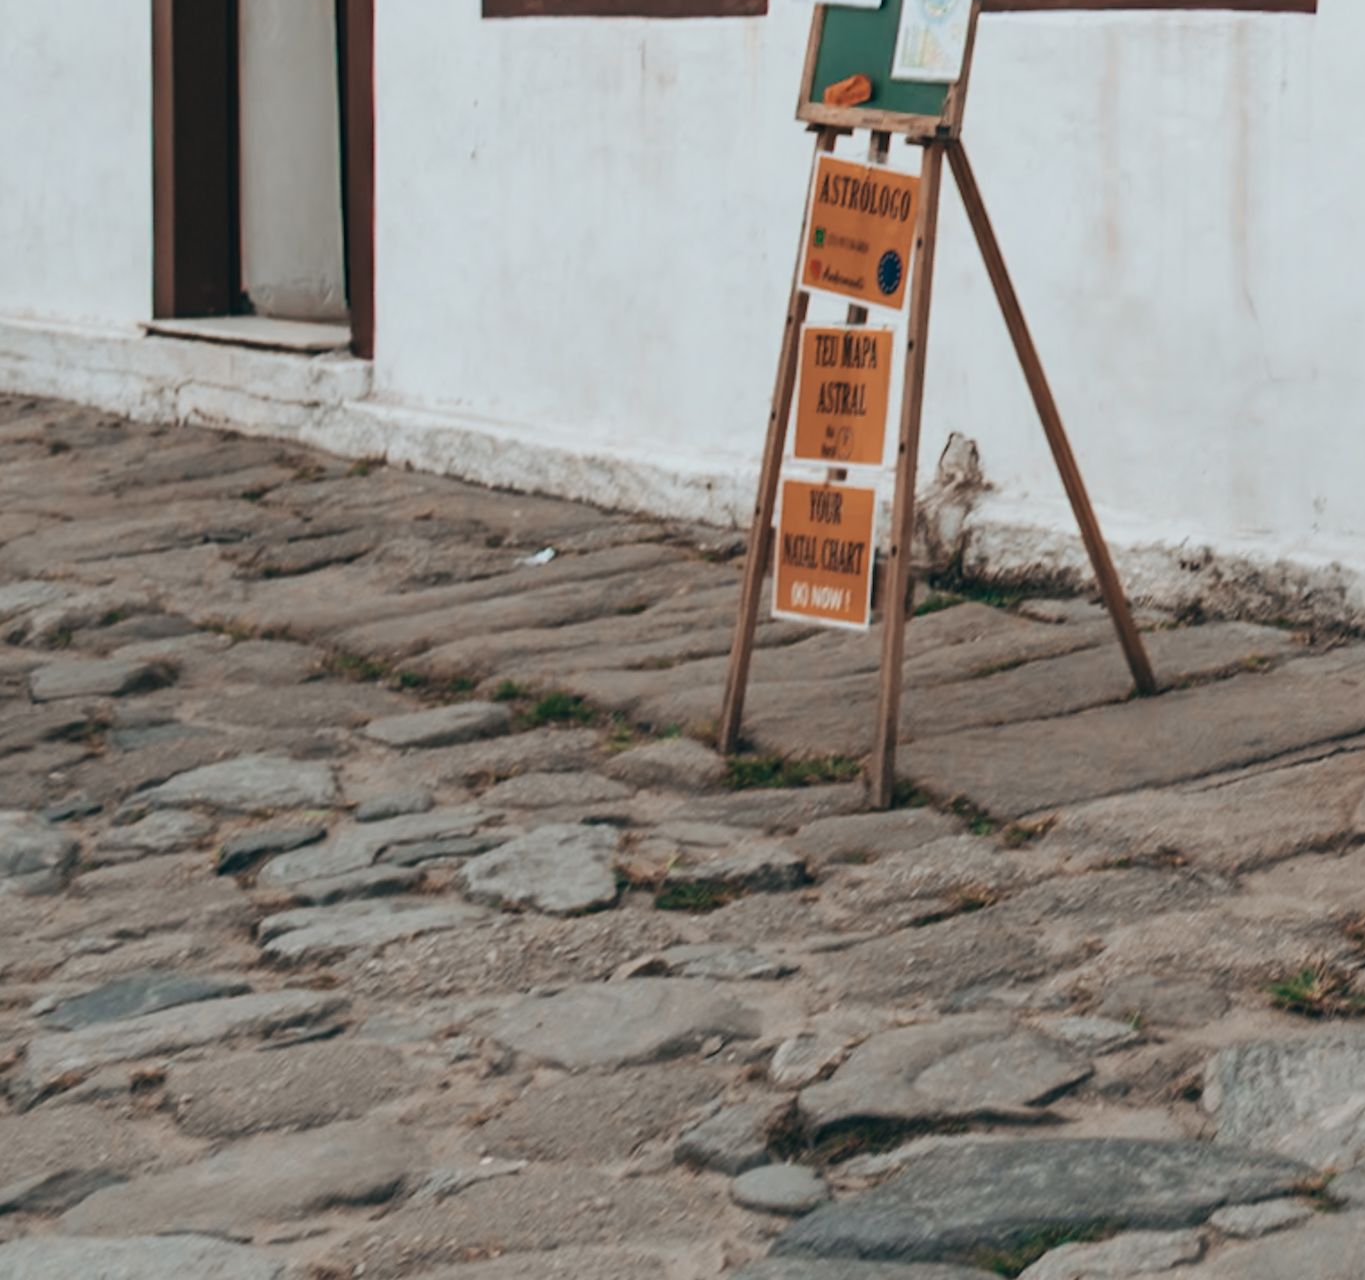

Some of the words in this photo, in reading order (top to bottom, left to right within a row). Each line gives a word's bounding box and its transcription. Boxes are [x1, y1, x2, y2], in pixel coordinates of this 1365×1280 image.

[820, 171, 912, 222] ASTRÓLOGO
[816, 334, 839, 367] TEU
[840, 335, 877, 369] MAPA
[816, 381, 867, 416] ASTRAL
[810, 490, 843, 524] YOUR
[783, 532, 817, 569] NATAL
[821, 538, 864, 575] CHART
